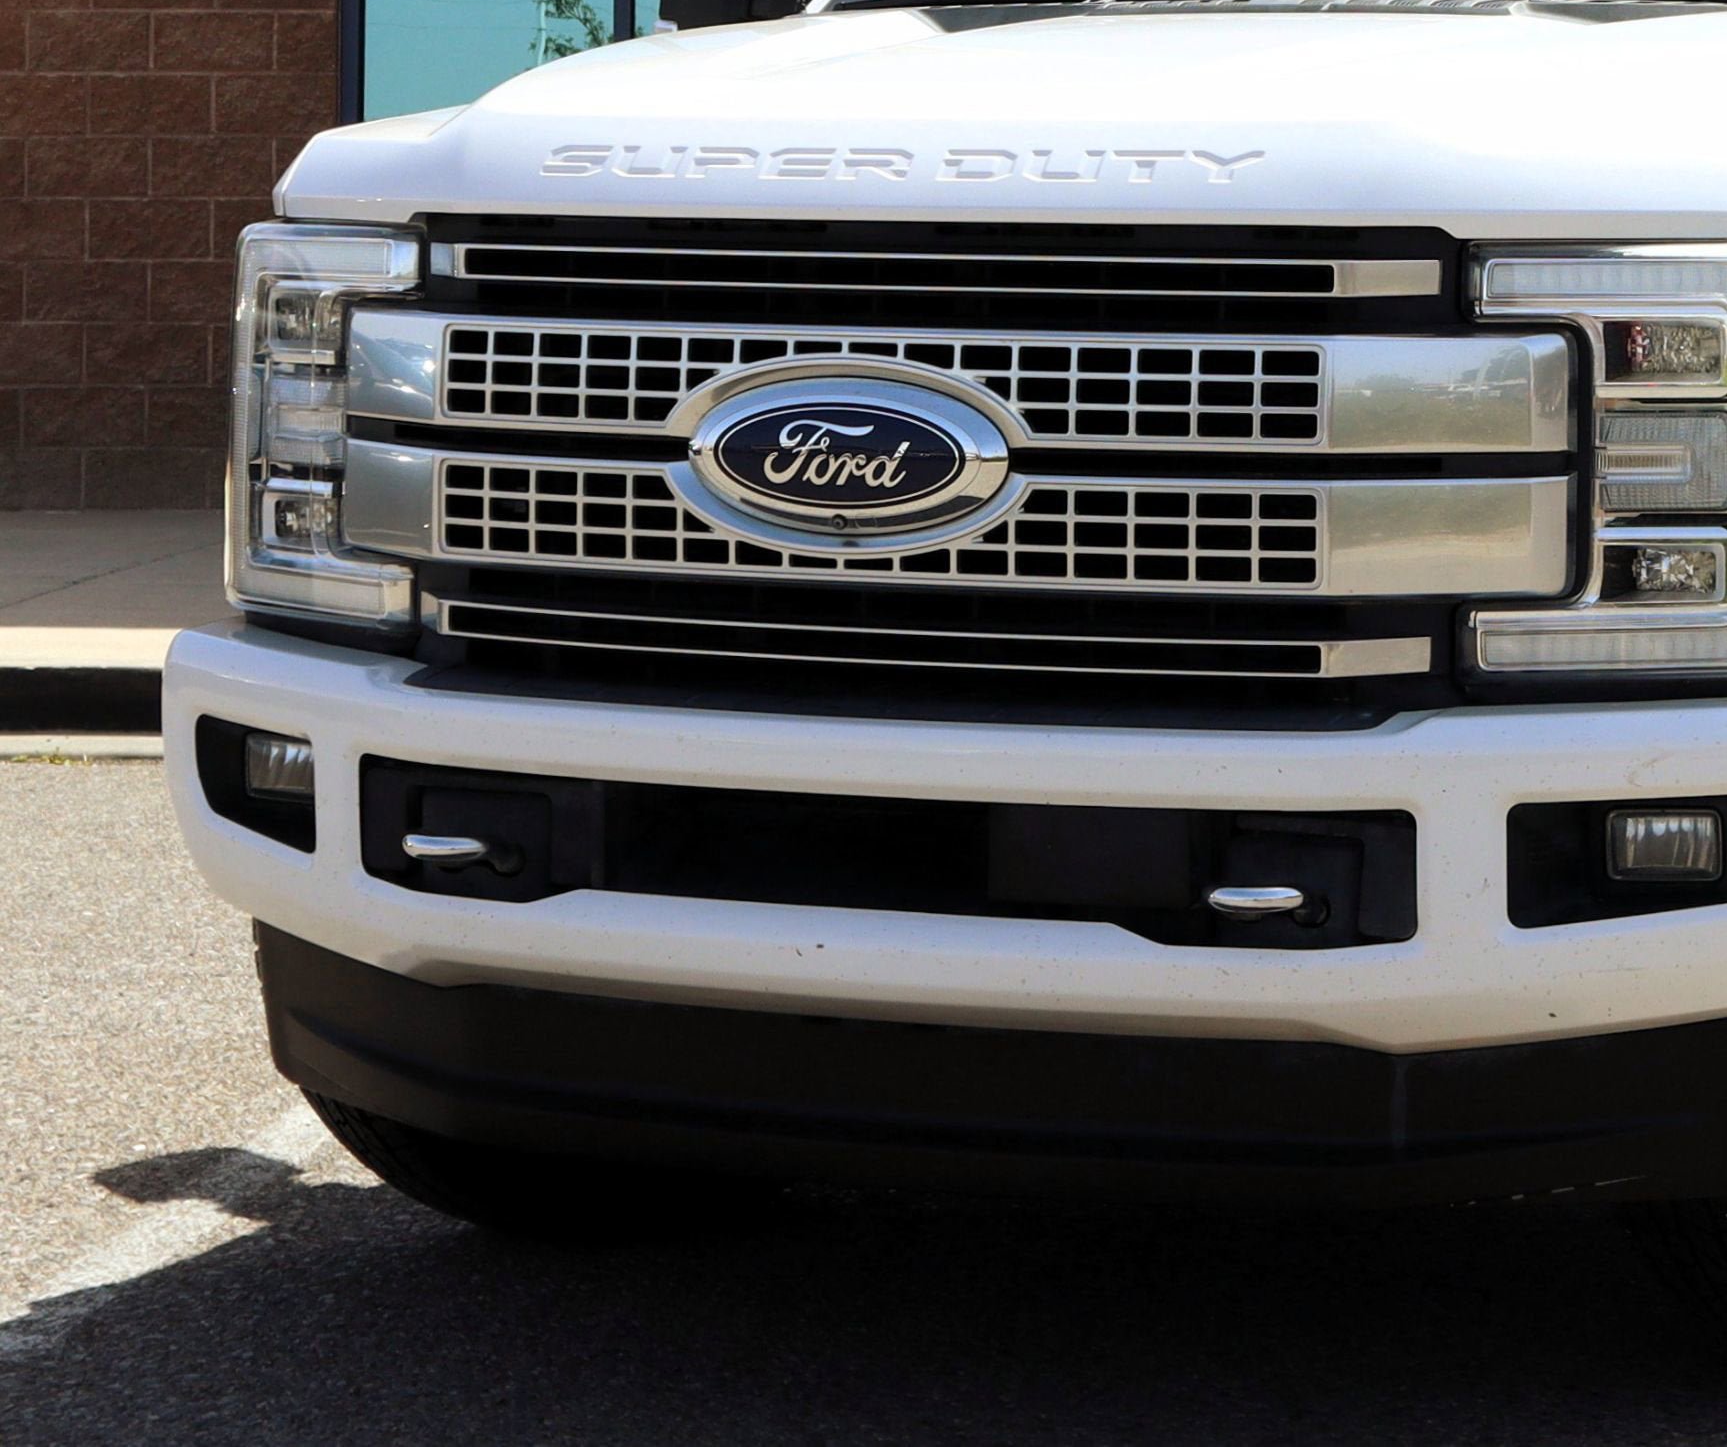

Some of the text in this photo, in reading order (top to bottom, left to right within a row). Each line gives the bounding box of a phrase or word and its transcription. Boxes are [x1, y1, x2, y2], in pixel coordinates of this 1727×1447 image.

[540, 144, 1267, 185] SUPER DUTY
[763, 418, 911, 489] Ford
